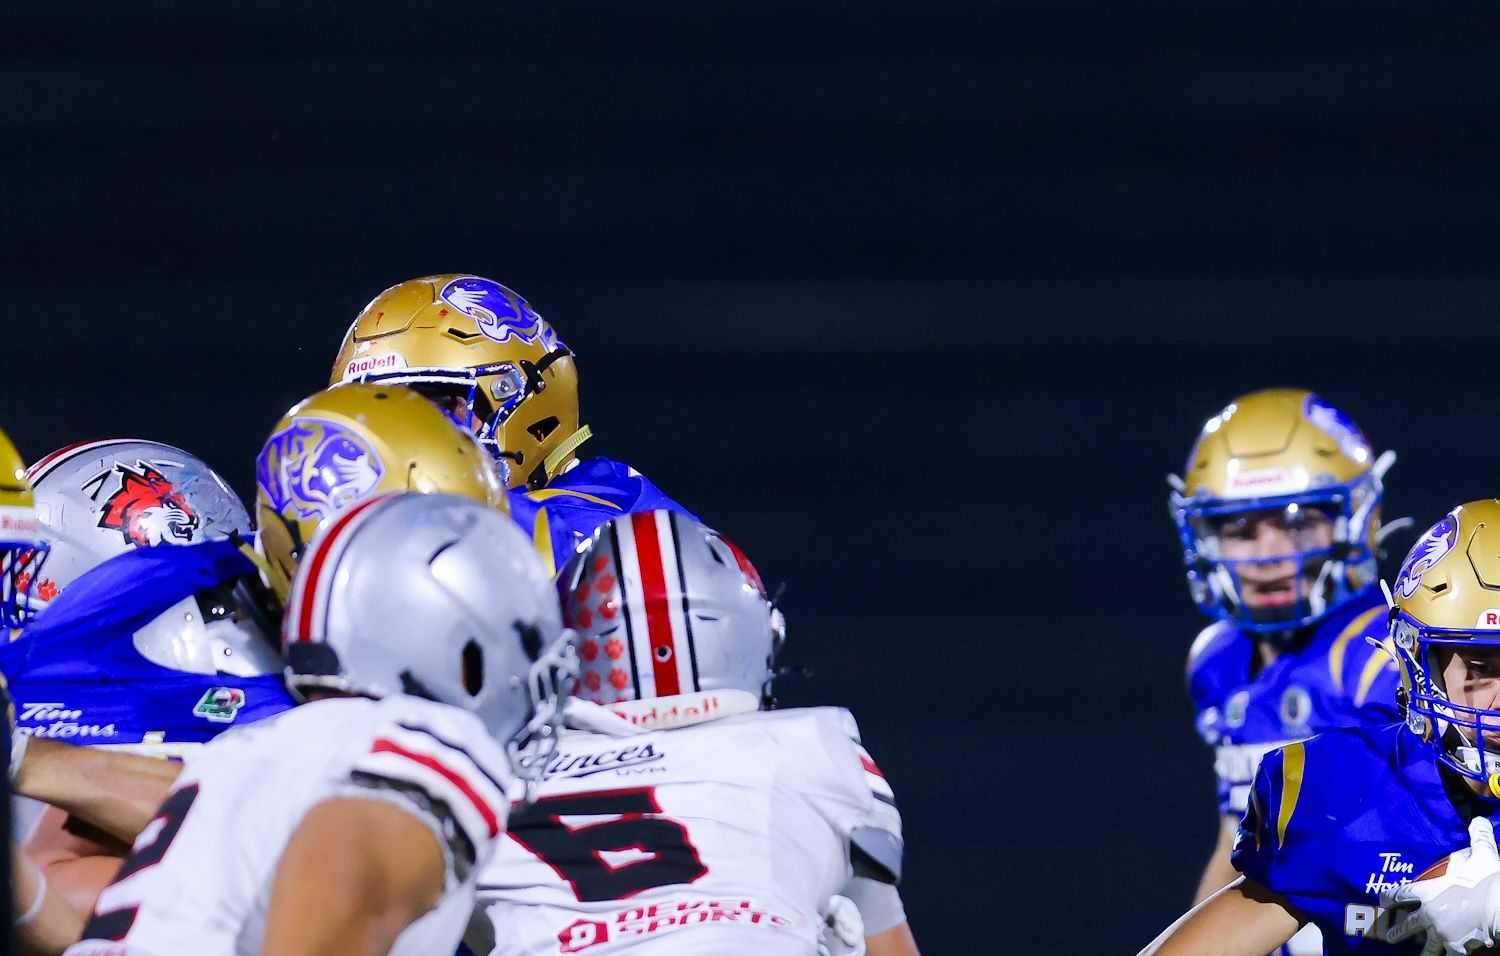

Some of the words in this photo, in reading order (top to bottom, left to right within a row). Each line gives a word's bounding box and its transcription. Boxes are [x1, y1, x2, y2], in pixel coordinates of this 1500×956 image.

[348, 355, 396, 374] Riddell
[20, 702, 83, 721] Tim
[16, 720, 116, 738] ortons
[507, 787, 709, 903] 6
[1379, 852, 1414, 874] Tim
